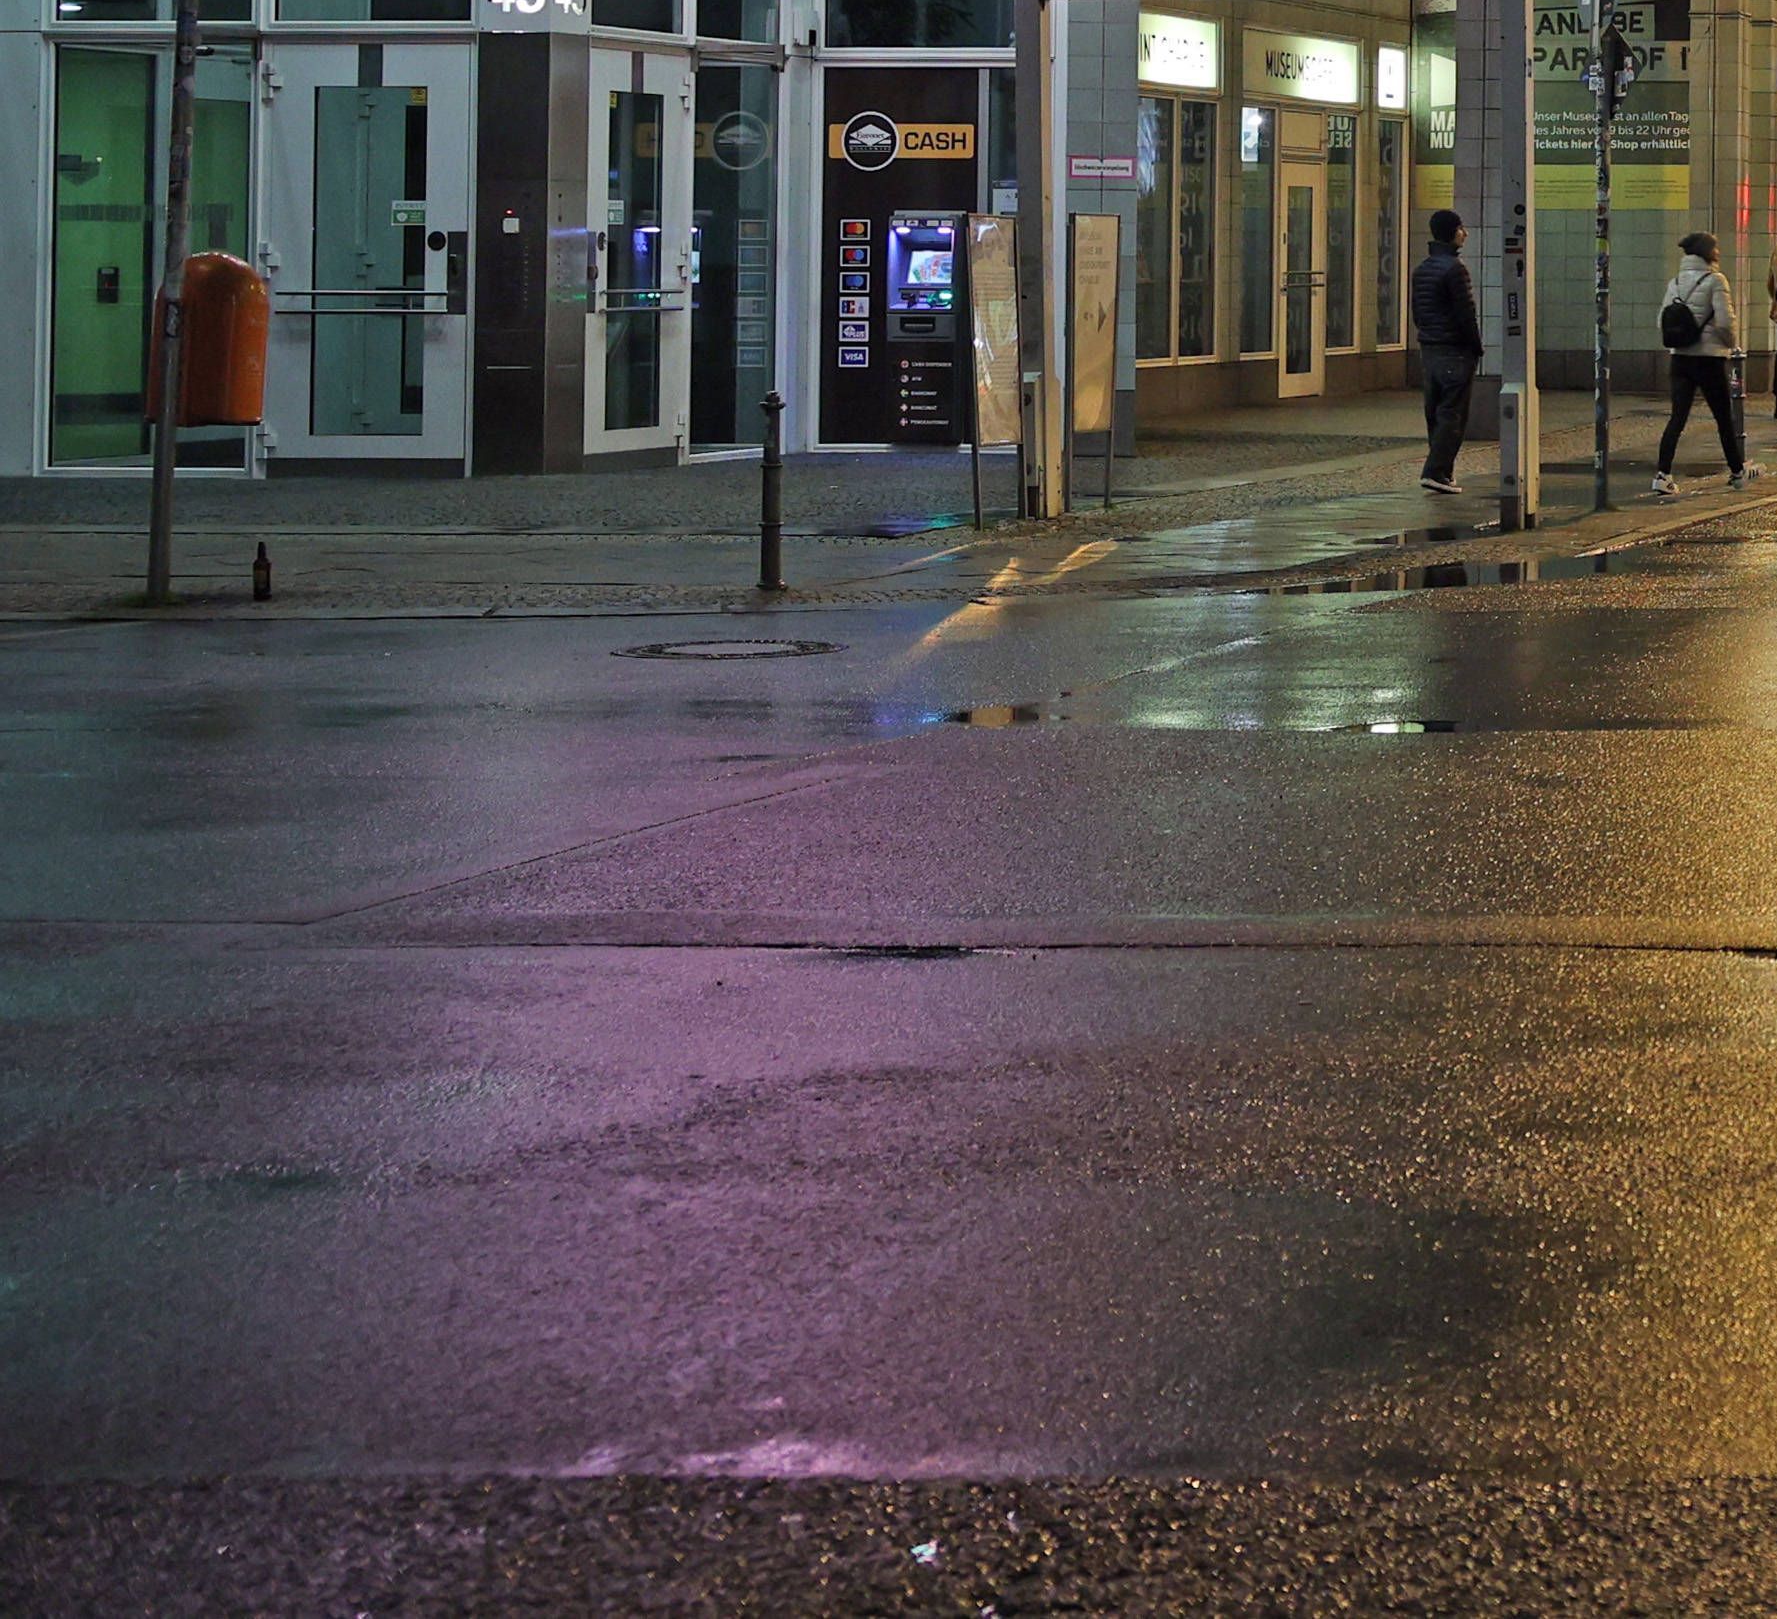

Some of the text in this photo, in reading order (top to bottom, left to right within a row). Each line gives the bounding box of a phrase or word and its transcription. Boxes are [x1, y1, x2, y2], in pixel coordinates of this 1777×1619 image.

[1562, 111, 1600, 122] Museu
[1613, 112, 1625, 122] st
[1625, 113, 1640, 122] an
[1641, 111, 1668, 122] allen
[1551, 125, 1586, 136] Jahres
[1609, 125, 1617, 136] 9
[1618, 124, 1634, 135] bis
[1636, 125, 1650, 135] 22
[1652, 124, 1671, 135] Uhr
[904, 132, 967, 151] CASH
[1571, 139, 1593, 150] hier
[1610, 140, 1639, 152] Shop
[843, 352, 864, 361] VISA
